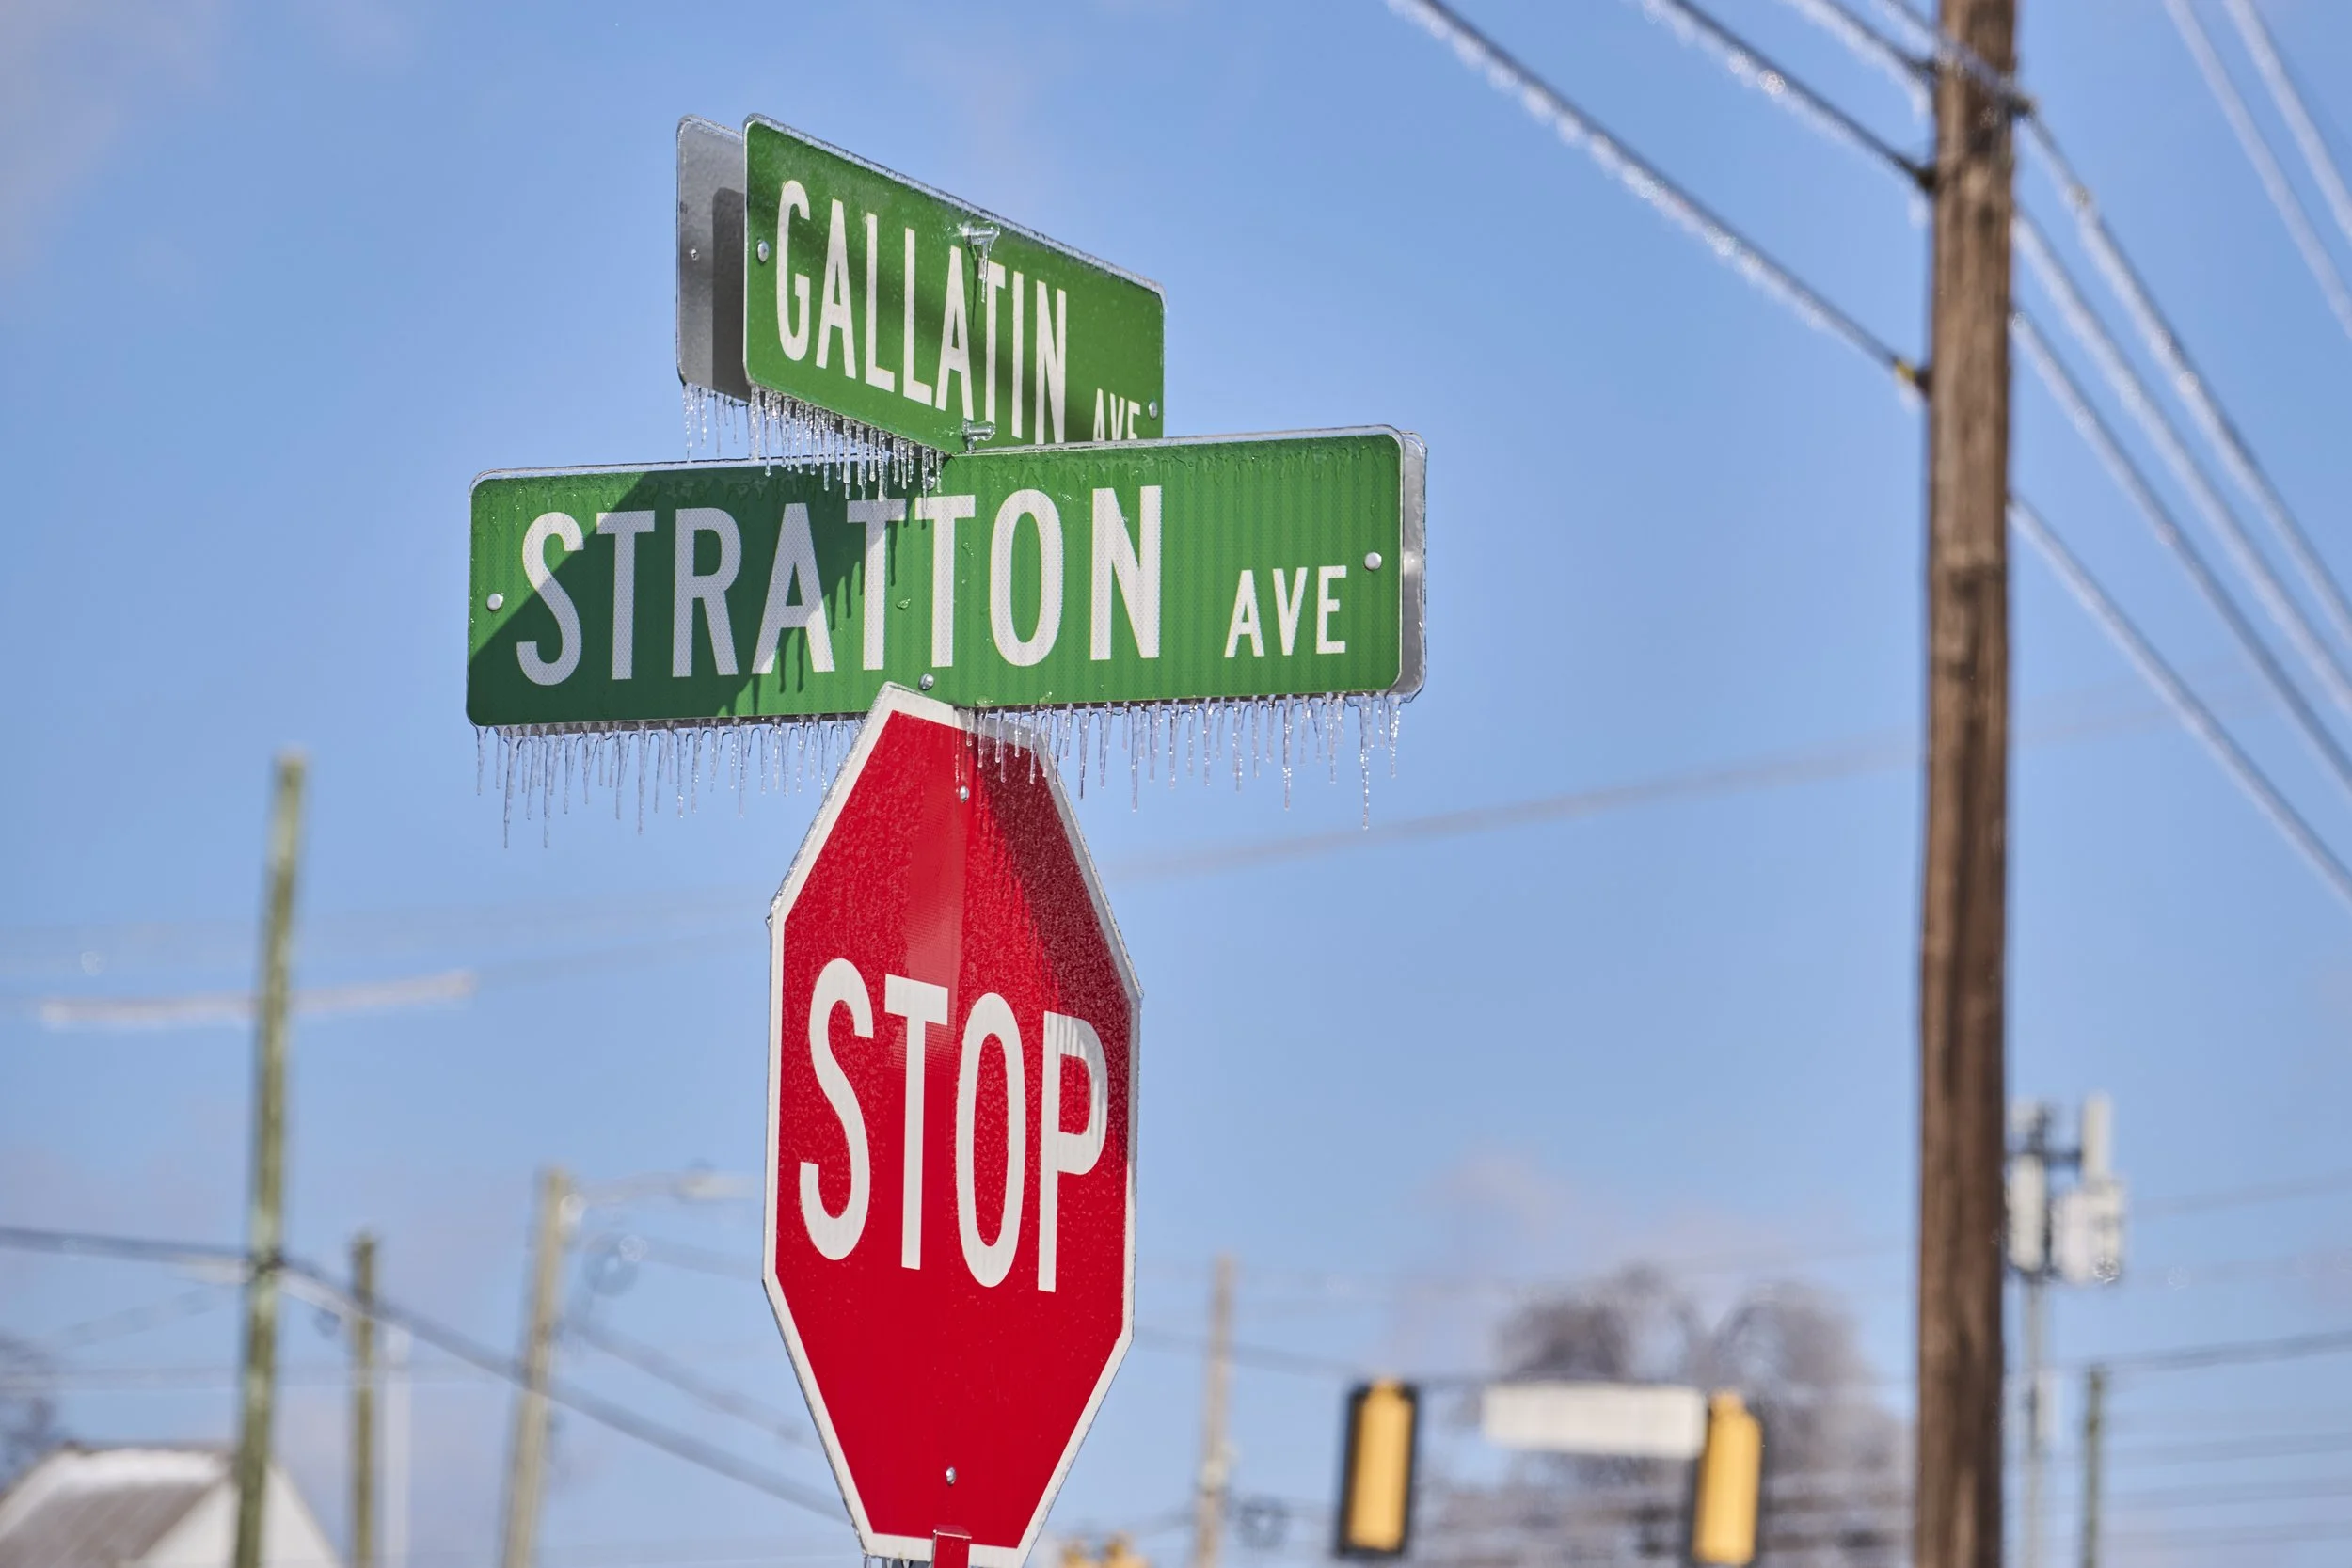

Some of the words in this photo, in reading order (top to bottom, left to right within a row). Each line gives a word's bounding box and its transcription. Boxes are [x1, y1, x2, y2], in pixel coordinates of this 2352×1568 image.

[776, 180, 1067, 445] GALLATIN
[516, 485, 1162, 687] STRATTON
[1224, 564, 1347, 658] AVE
[799, 958, 1108, 1293] STOP
